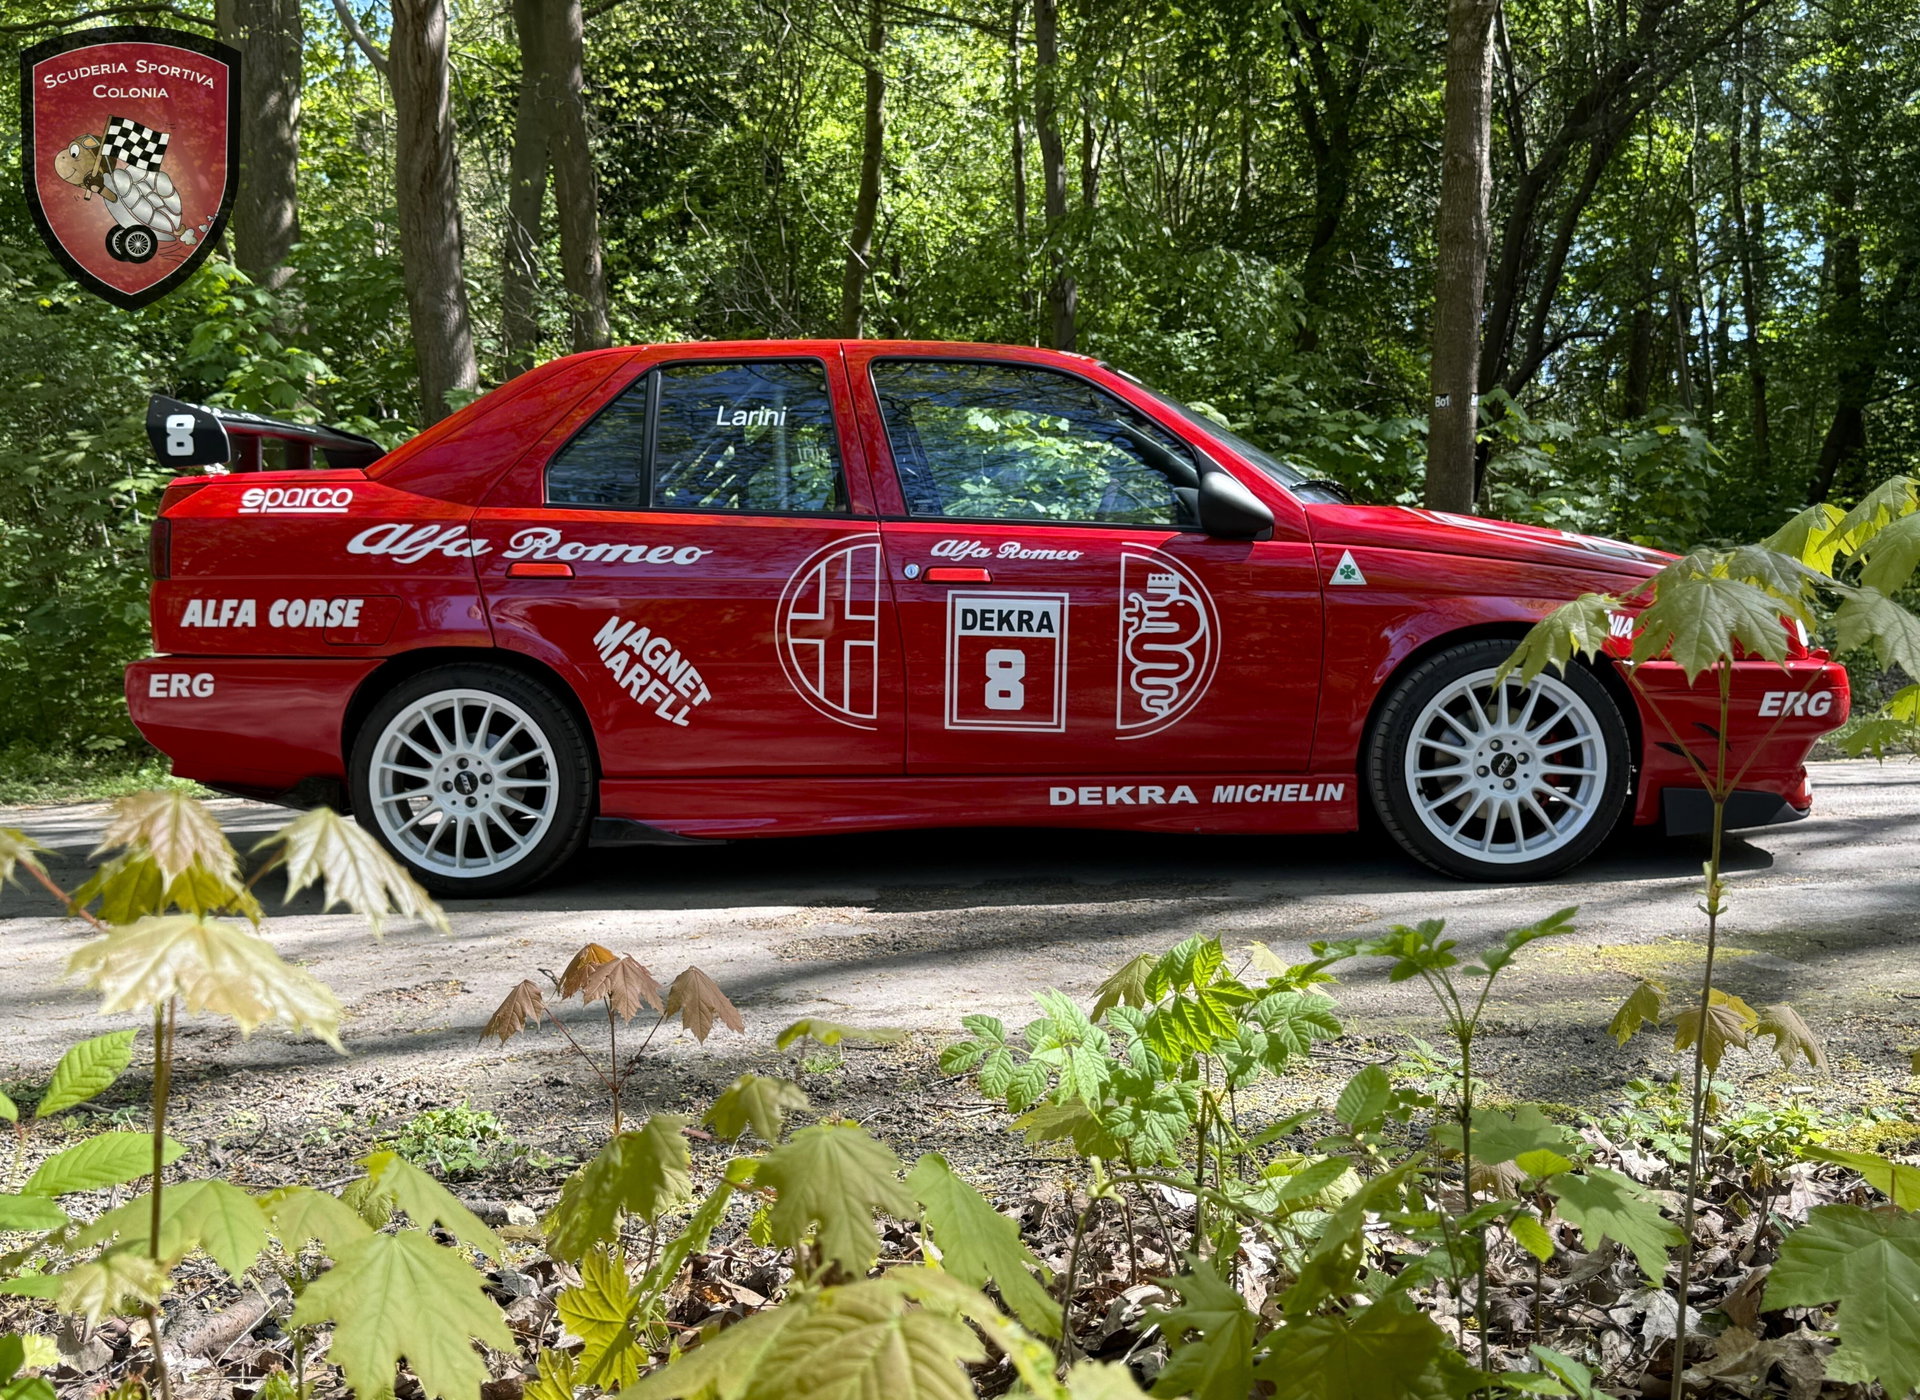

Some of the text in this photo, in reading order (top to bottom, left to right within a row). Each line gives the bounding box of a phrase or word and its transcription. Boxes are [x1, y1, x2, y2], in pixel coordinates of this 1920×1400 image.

[717, 405, 787, 426] Larini
[165, 414, 196, 456] 8
[239, 487, 353, 513] sparco
[347, 523, 713, 565] Alfa Romeo
[930, 539, 1084, 562] Alfa Romeo
[180, 598, 364, 628] ALFA CORSE
[960, 608, 1055, 634] DEKRA
[148, 673, 215, 697] ERG
[984, 648, 1026, 711] 8
[1757, 690, 1832, 717] ERG
[1049, 783, 1345, 806] DEKRA MICHELIN
